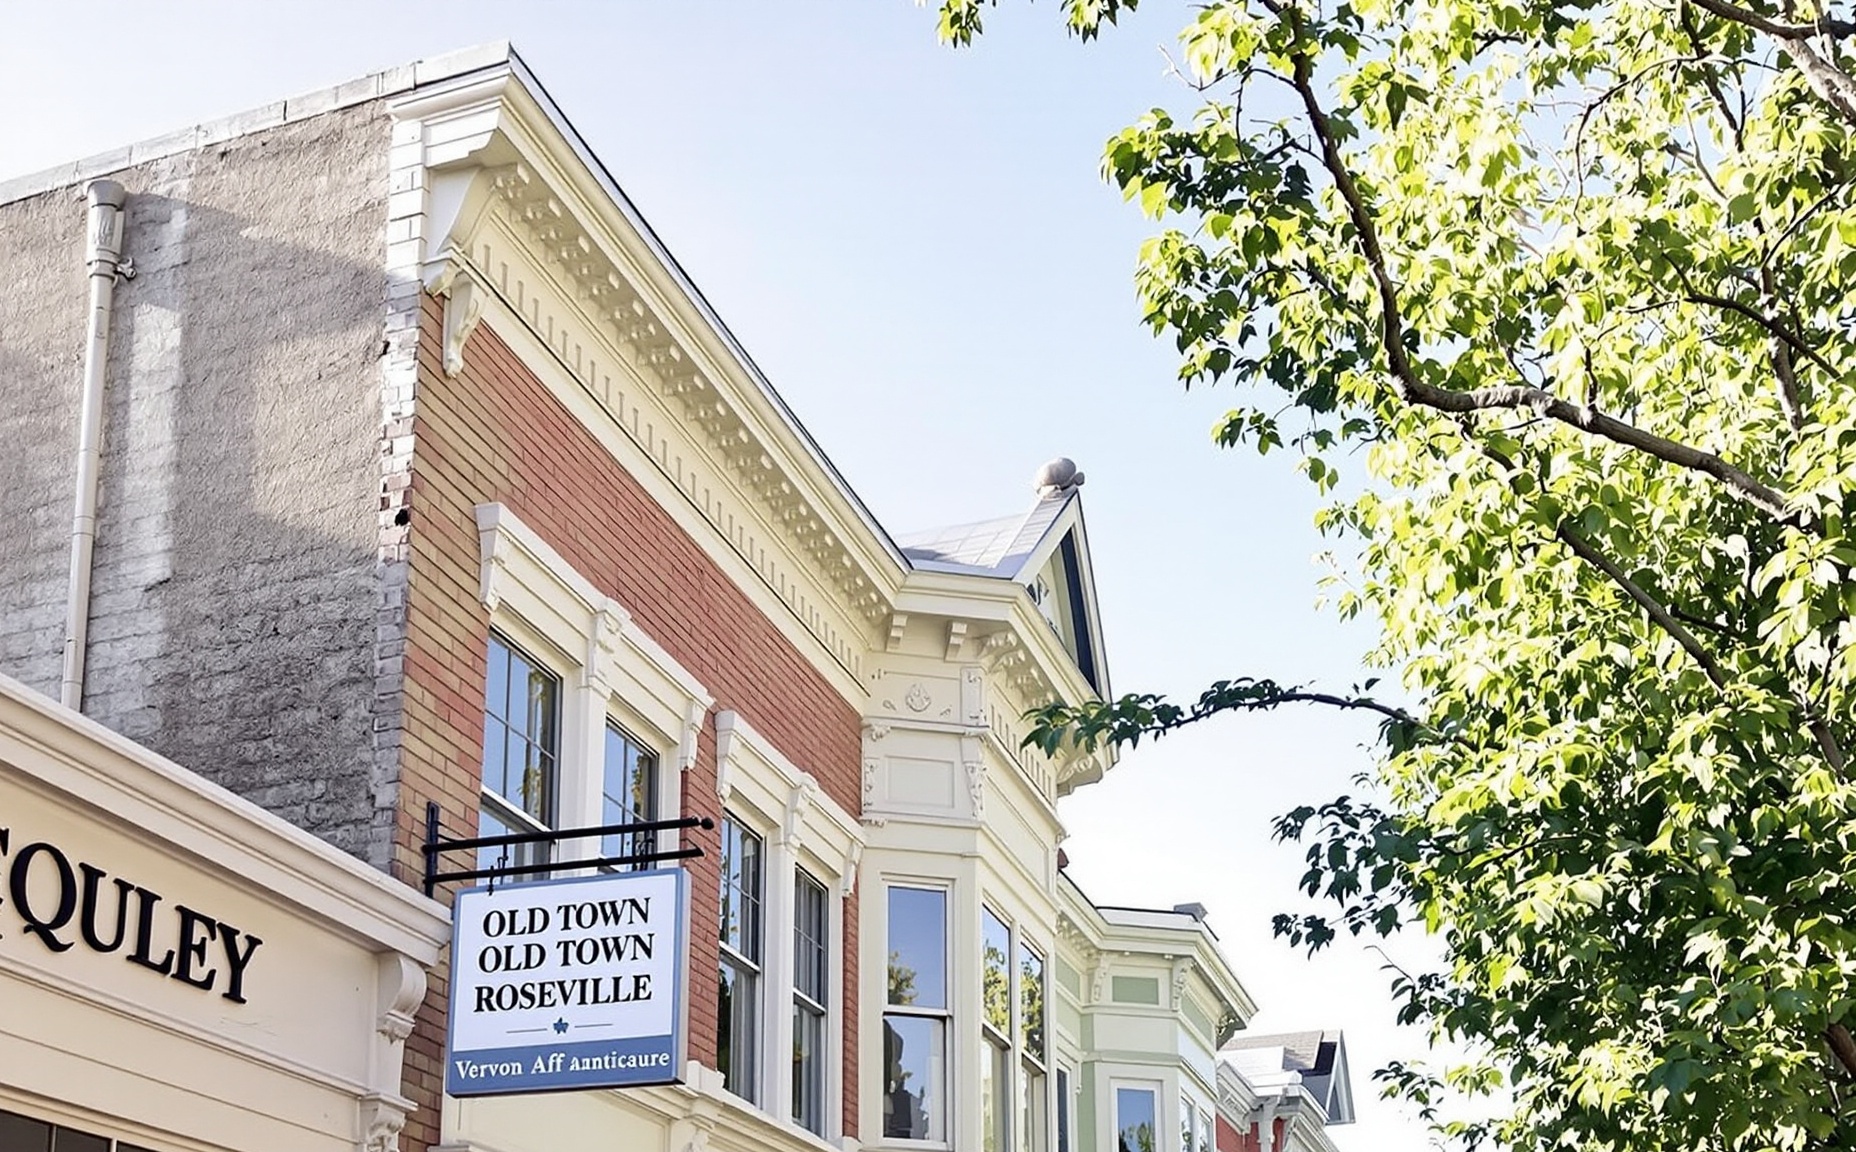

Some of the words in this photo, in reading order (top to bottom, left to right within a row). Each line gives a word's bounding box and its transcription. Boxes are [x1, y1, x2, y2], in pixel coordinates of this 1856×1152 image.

[0, 828, 263, 1004] QULEY
[482, 907, 550, 938] OLD
[557, 897, 651, 932] TOWN
[478, 943, 546, 974] OLD
[556, 933, 655, 968] TOWN
[473, 974, 653, 1013] ROSEVILLE
[455, 1060, 523, 1080] Vervon
[530, 1053, 566, 1075] Aff
